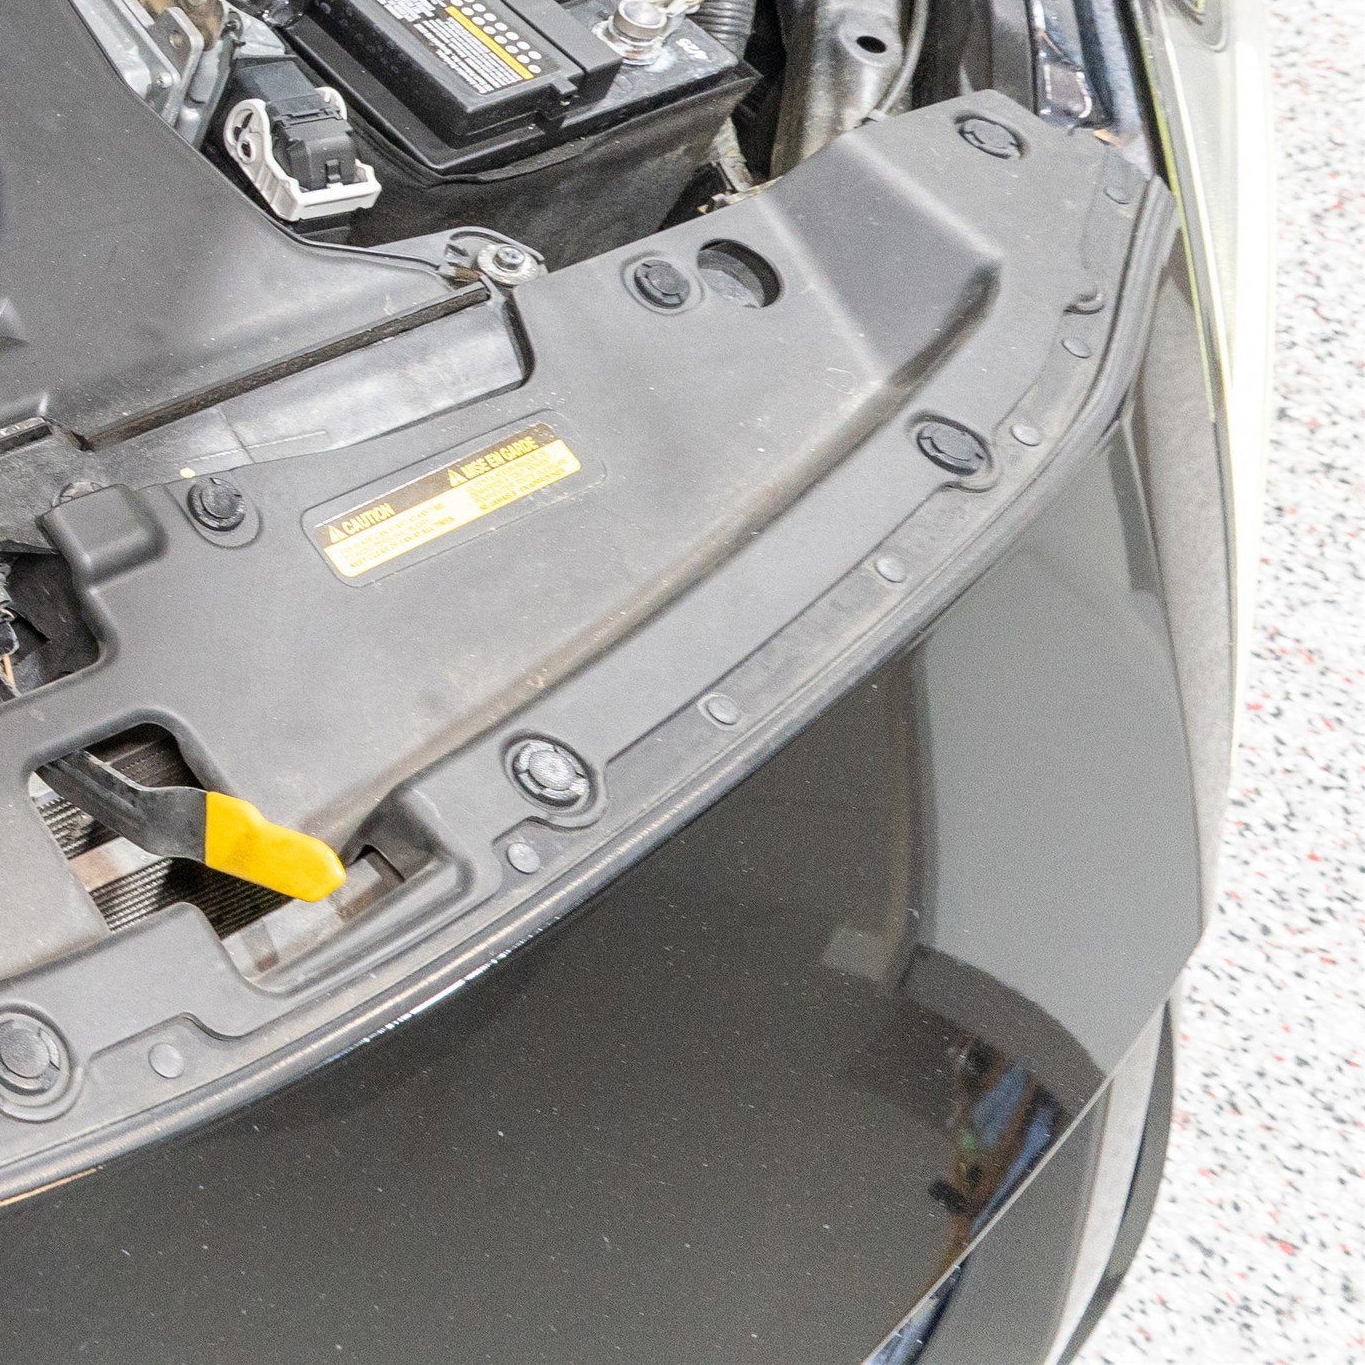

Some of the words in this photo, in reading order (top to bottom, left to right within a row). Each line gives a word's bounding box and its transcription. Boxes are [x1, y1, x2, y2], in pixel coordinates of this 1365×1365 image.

[460, 457, 491, 481] MISE
[489, 448, 506, 470] EN
[503, 435, 540, 461] GARDE
[342, 502, 396, 535] CAUTION
